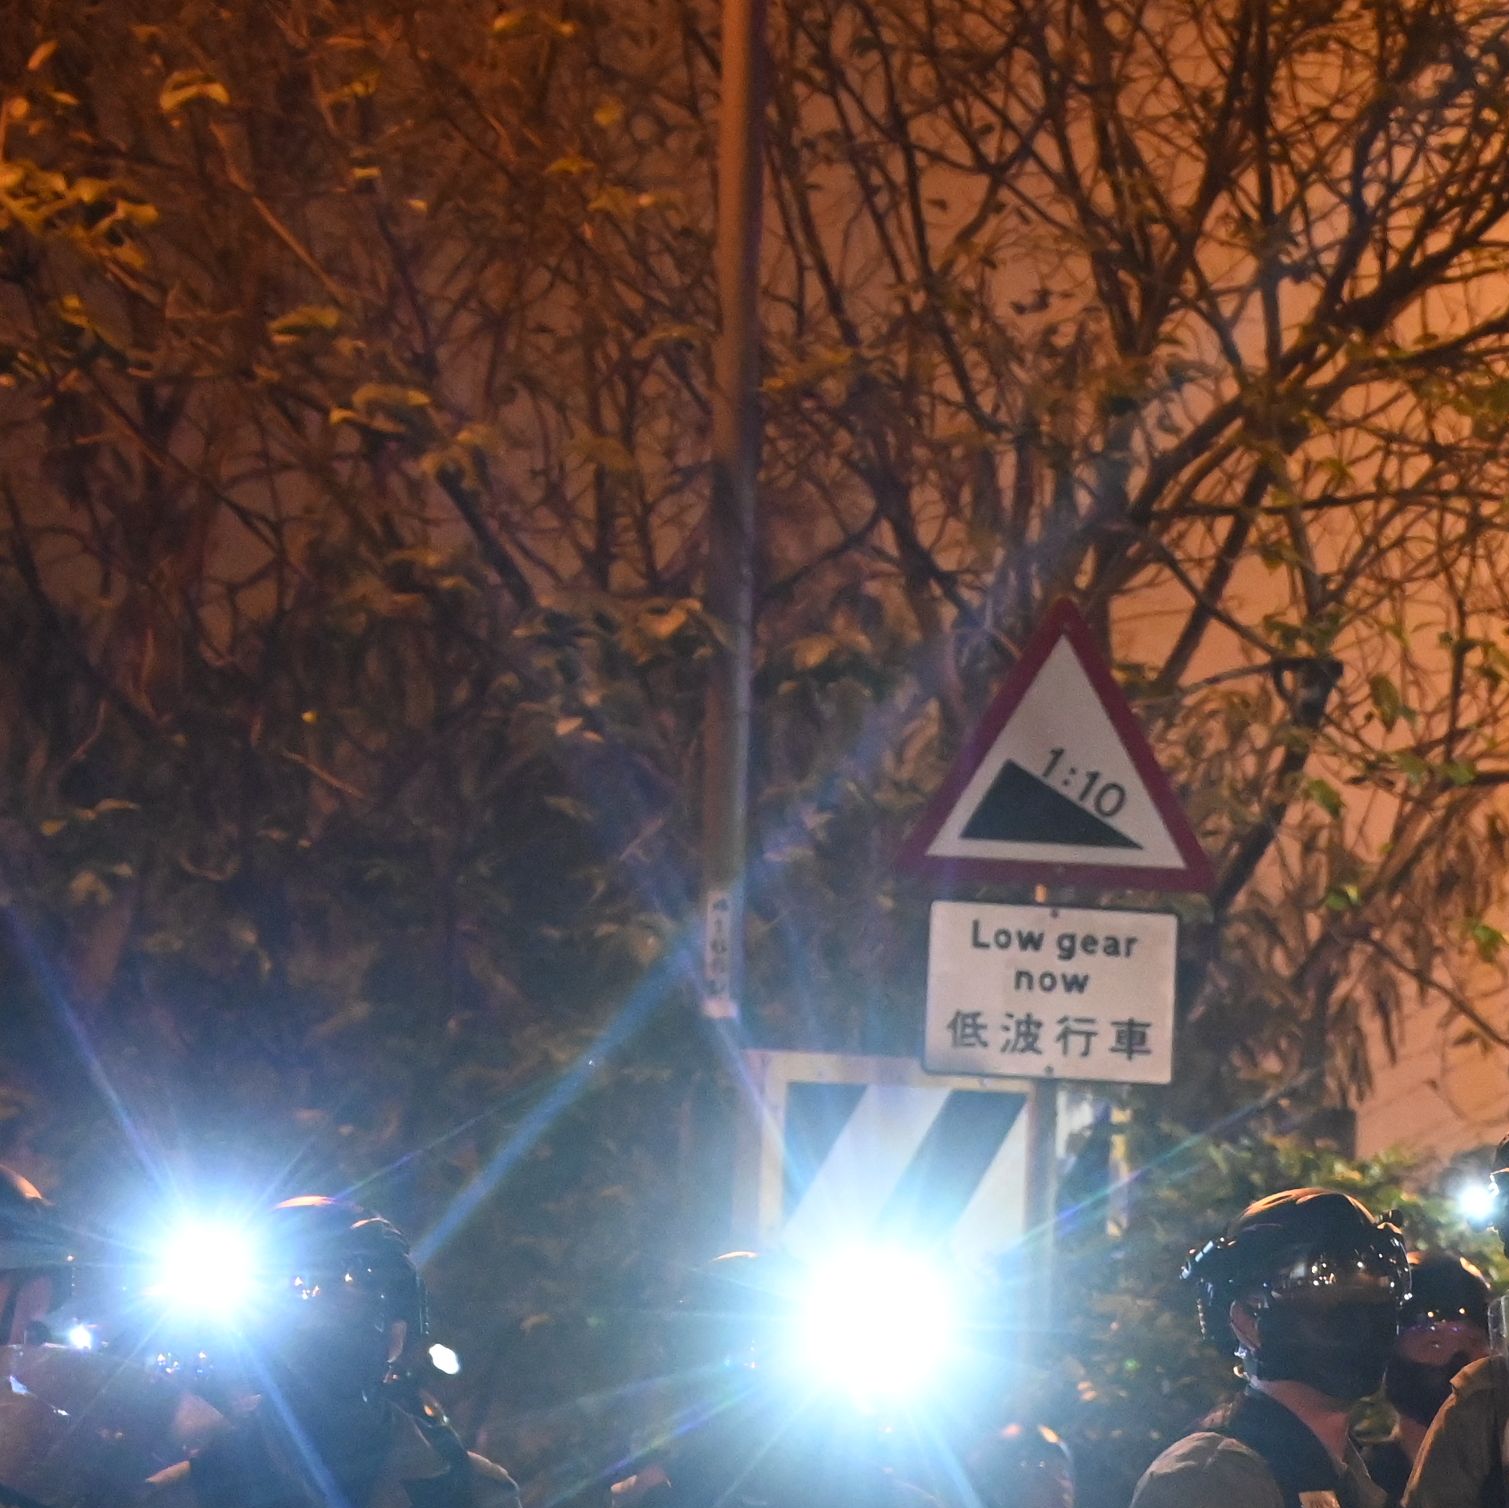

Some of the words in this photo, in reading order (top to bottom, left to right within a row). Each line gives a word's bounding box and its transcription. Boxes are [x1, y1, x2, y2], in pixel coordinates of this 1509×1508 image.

[1038, 746, 1127, 819] 1:10
[972, 920, 1045, 954] Low
[1056, 931, 1139, 961] gear
[1014, 966, 1090, 994] now
[946, 1010, 1152, 1061] 低波行車
